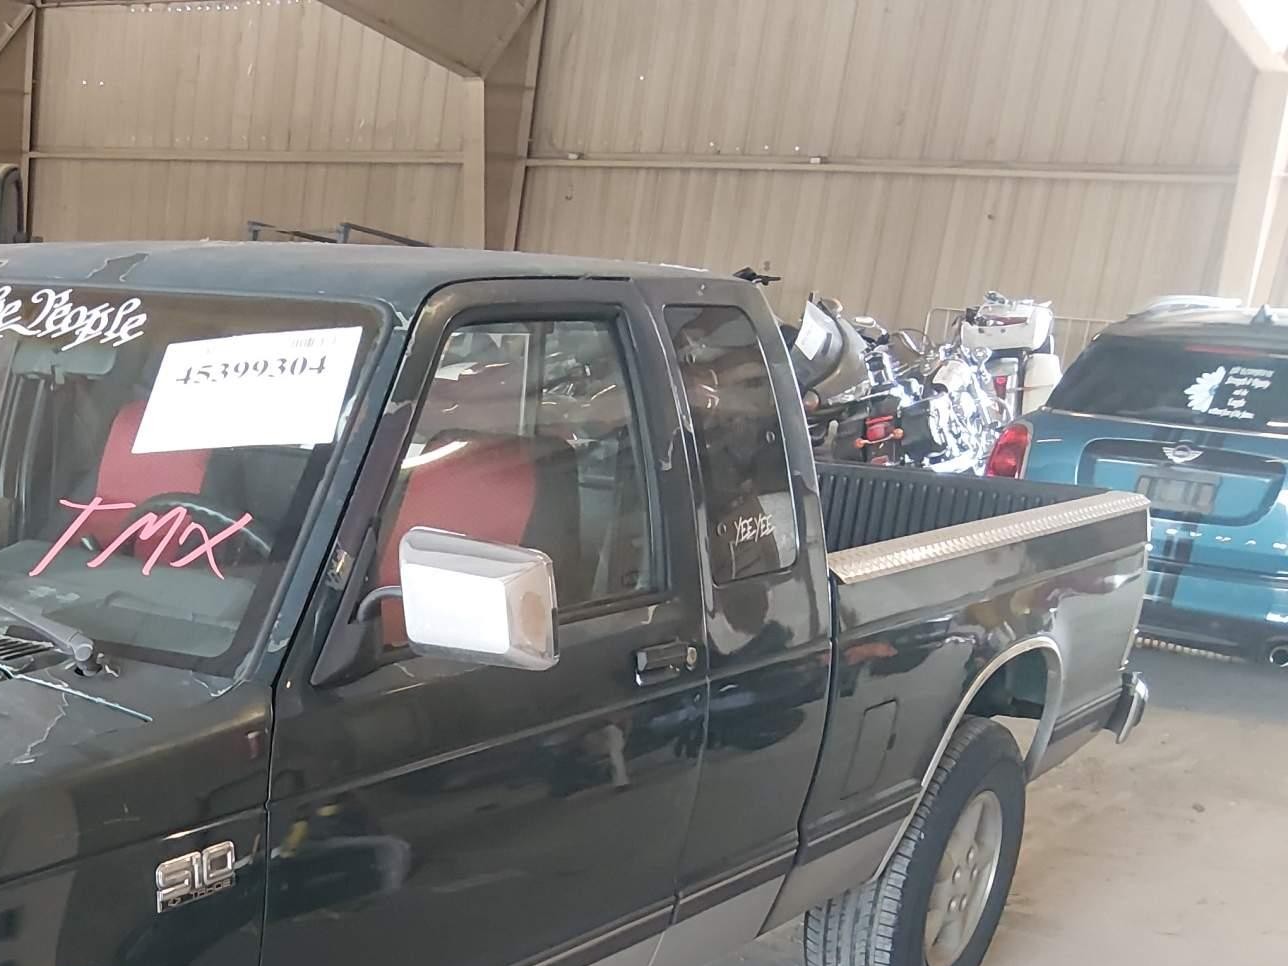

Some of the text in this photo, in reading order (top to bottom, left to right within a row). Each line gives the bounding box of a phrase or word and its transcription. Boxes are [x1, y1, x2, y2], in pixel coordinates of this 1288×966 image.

[26, 288, 148, 351] People
[175, 355, 328, 385] 45399304
[155, 840, 236, 904] S10
